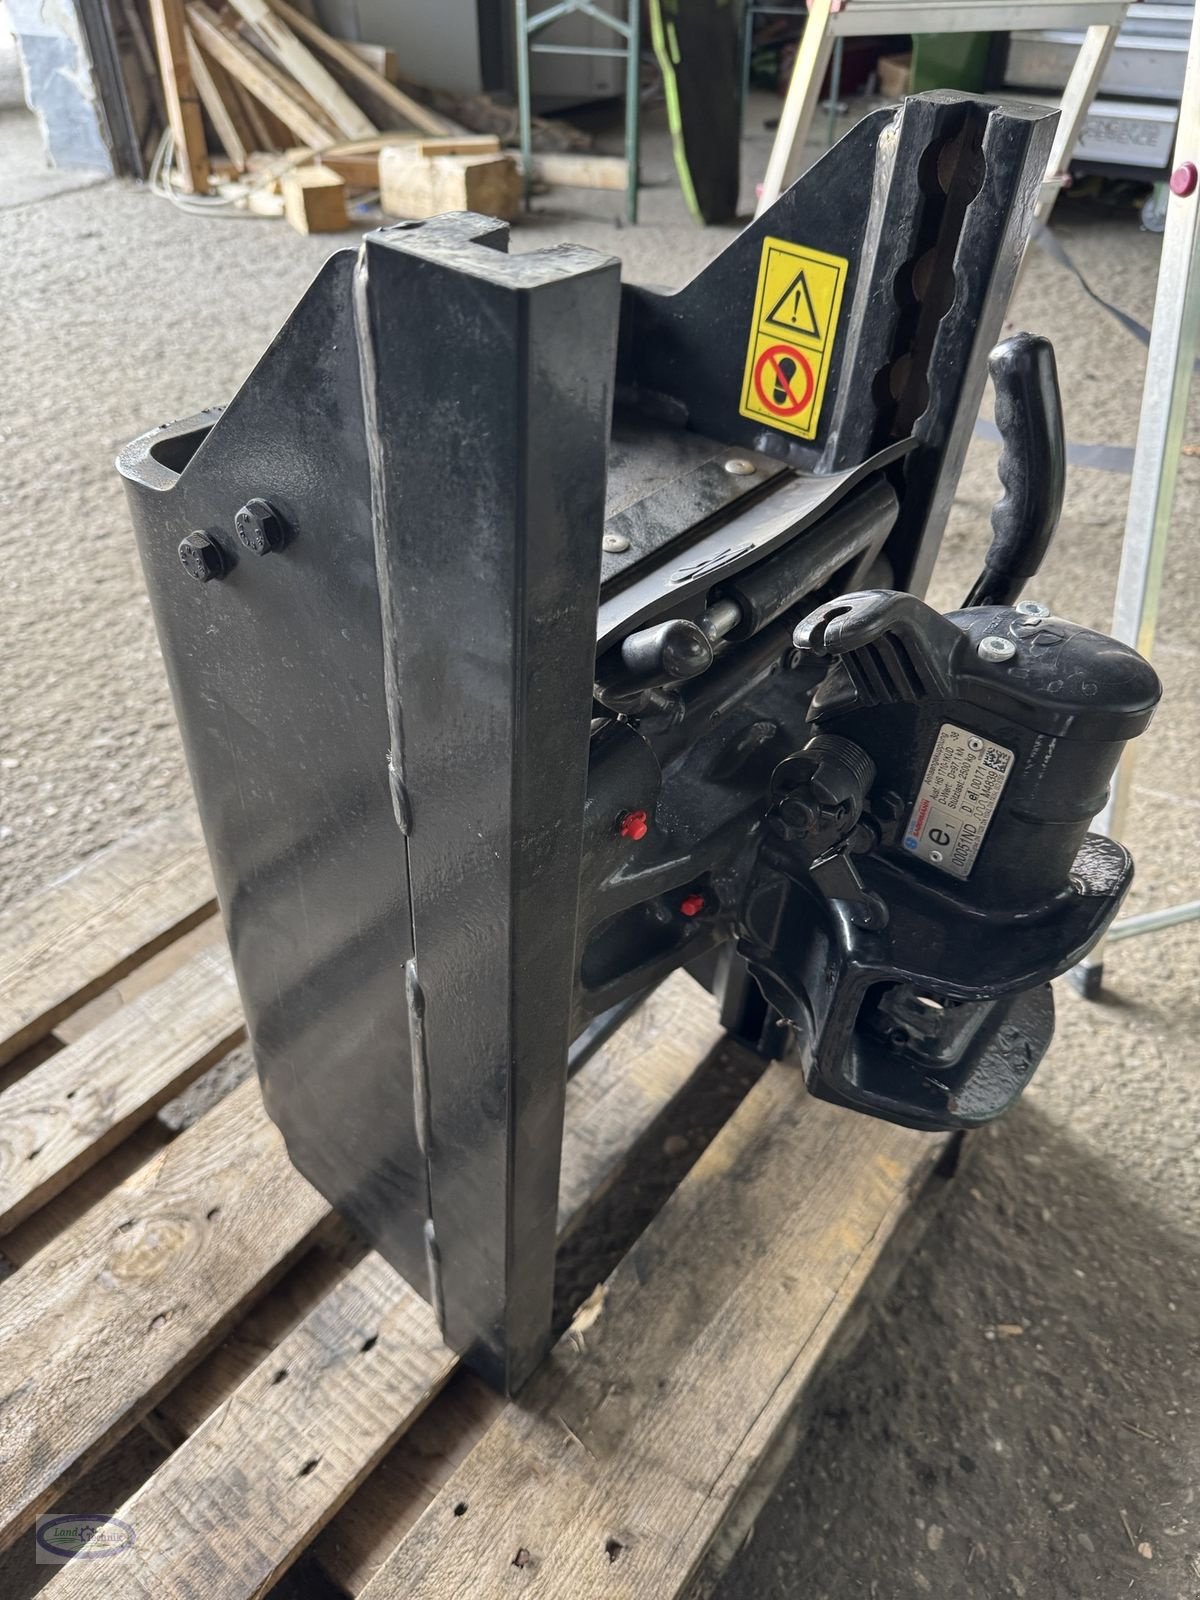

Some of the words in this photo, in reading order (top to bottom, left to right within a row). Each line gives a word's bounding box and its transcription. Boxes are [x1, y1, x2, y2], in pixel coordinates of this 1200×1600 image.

[954, 746, 965, 757] kN
[957, 759, 971, 780] 2500
[964, 752, 976, 764] kg
[961, 804, 972, 813] D
[970, 765, 987, 790] 00171
[981, 770, 998, 798] M4839
[951, 822, 977, 867] 00051ND
